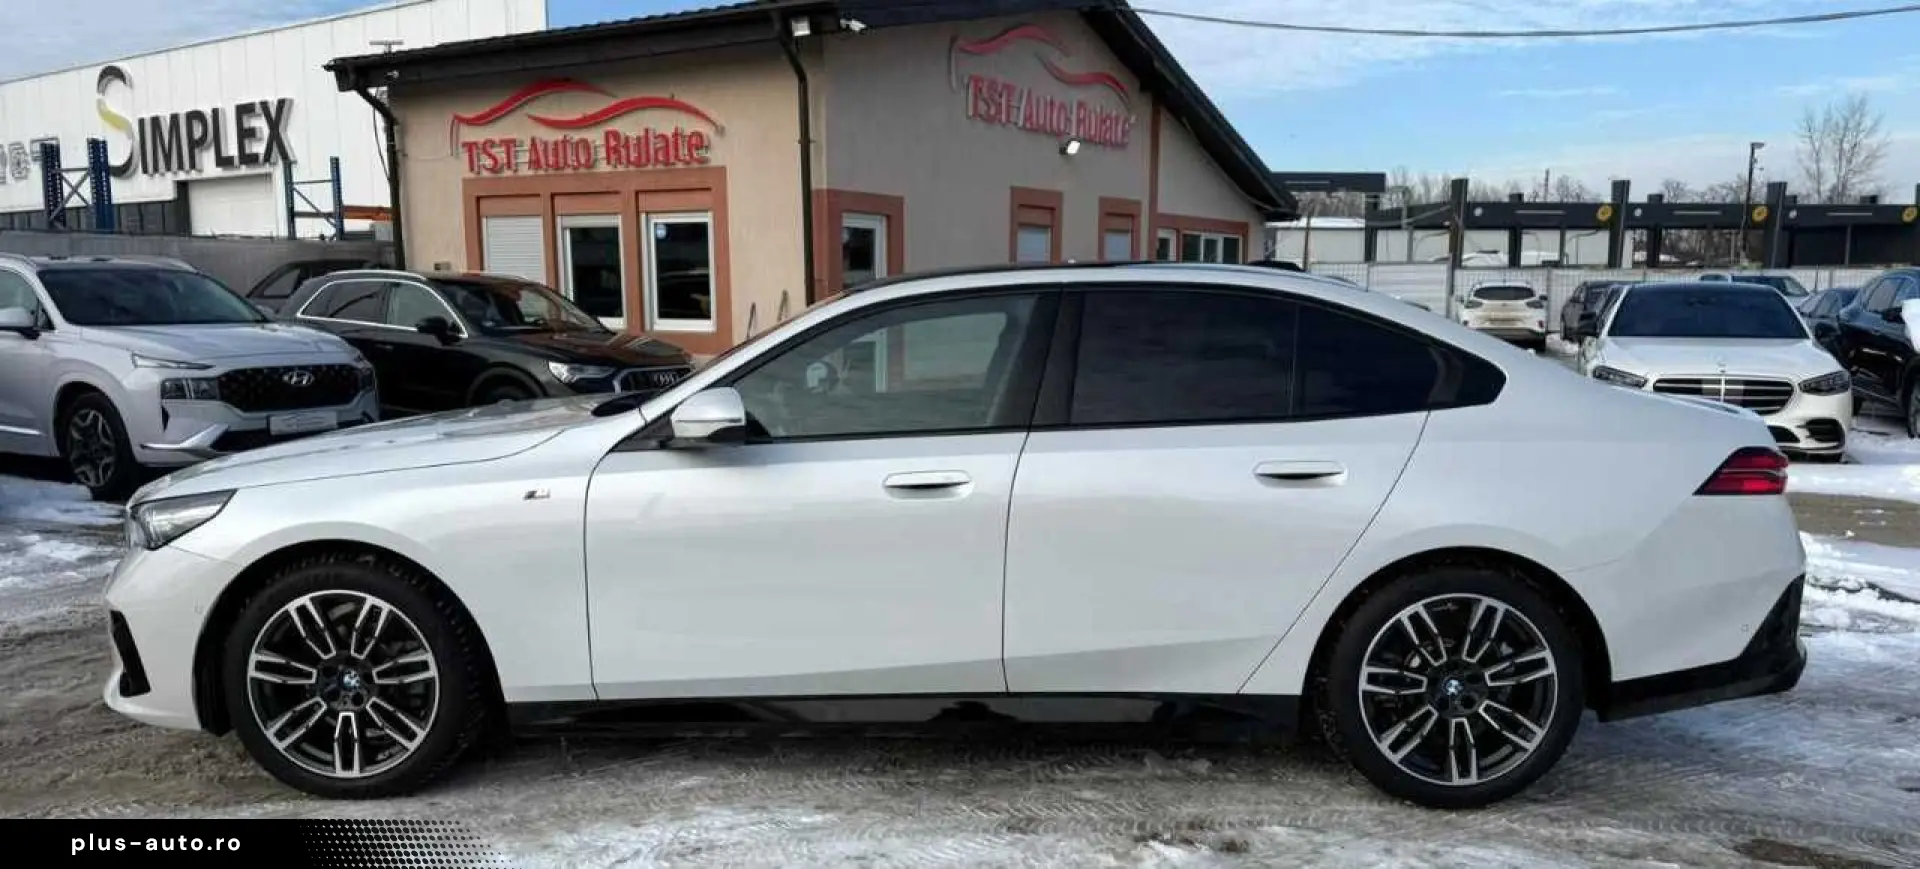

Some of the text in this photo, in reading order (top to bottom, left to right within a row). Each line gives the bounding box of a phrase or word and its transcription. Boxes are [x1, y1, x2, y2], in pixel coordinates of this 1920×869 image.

[97, 65, 292, 178] SIMPLEX
[967, 74, 1130, 148] TST Auto Rulate
[462, 126, 706, 174] TST Auto Rulate
